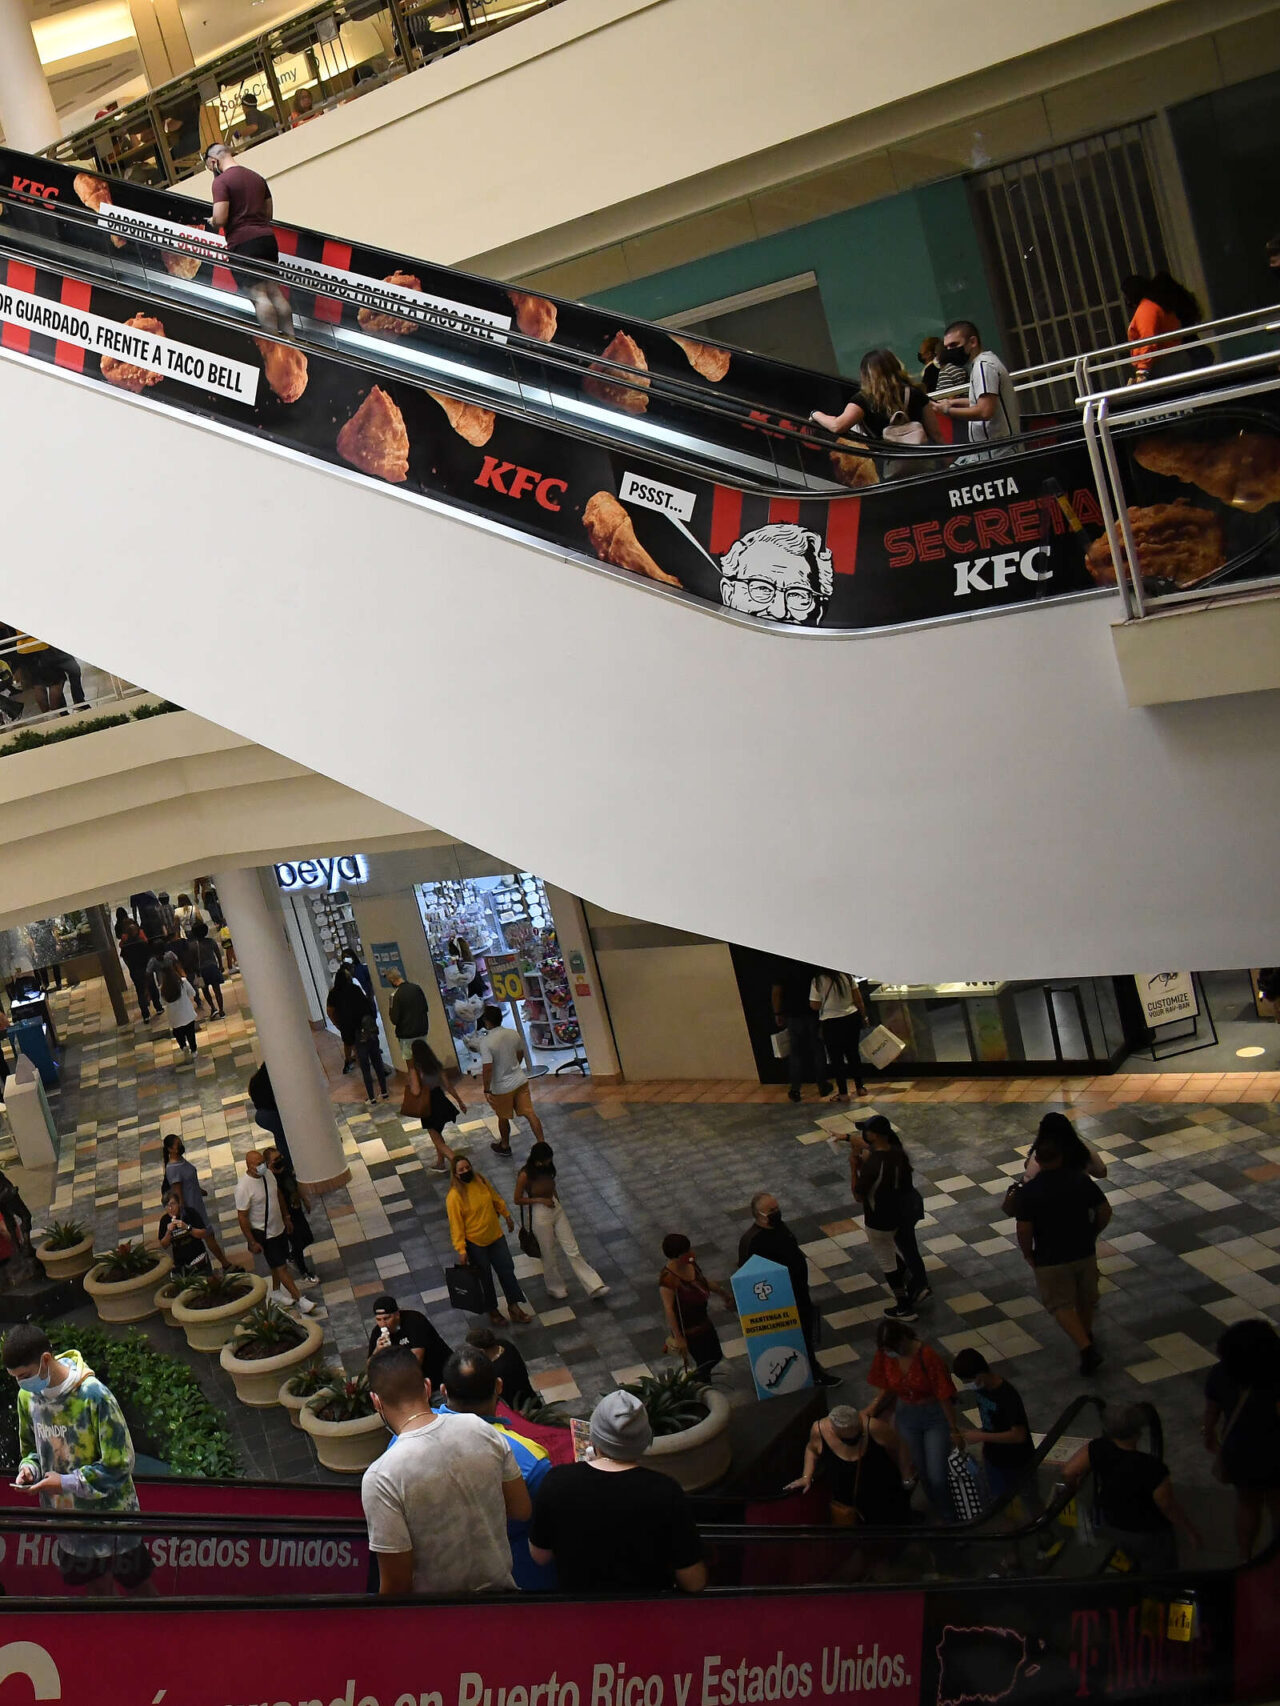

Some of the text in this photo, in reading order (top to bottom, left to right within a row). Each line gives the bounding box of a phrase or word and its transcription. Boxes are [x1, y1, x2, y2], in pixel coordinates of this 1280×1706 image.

[15, 302, 92, 345] GUARDADO,
[96, 326, 150, 361] FRENTE
[151, 345, 162, 366] A
[167, 348, 205, 379] TACO
[207, 362, 243, 394] BELL
[474, 456, 568, 512] KFC
[628, 481, 683, 514] PSSST...
[949, 476, 1019, 508] RECETA
[884, 488, 1105, 569] SECRETA
[953, 546, 1053, 596] KFC
[1147, 992, 1189, 1012] CUSTOMIZE
[1148, 1002, 1190, 1018] YOUR RAY-BAN
[746, 1318, 798, 1334] DISTANCIAMIENTO
[750, 1312, 782, 1324] MANTENGA
[260, 1535, 359, 1568] Unidos.
[592, 1662, 664, 1706] Rico
[703, 1650, 812, 1706] Estados
[821, 1643, 912, 1696] Unidos.
